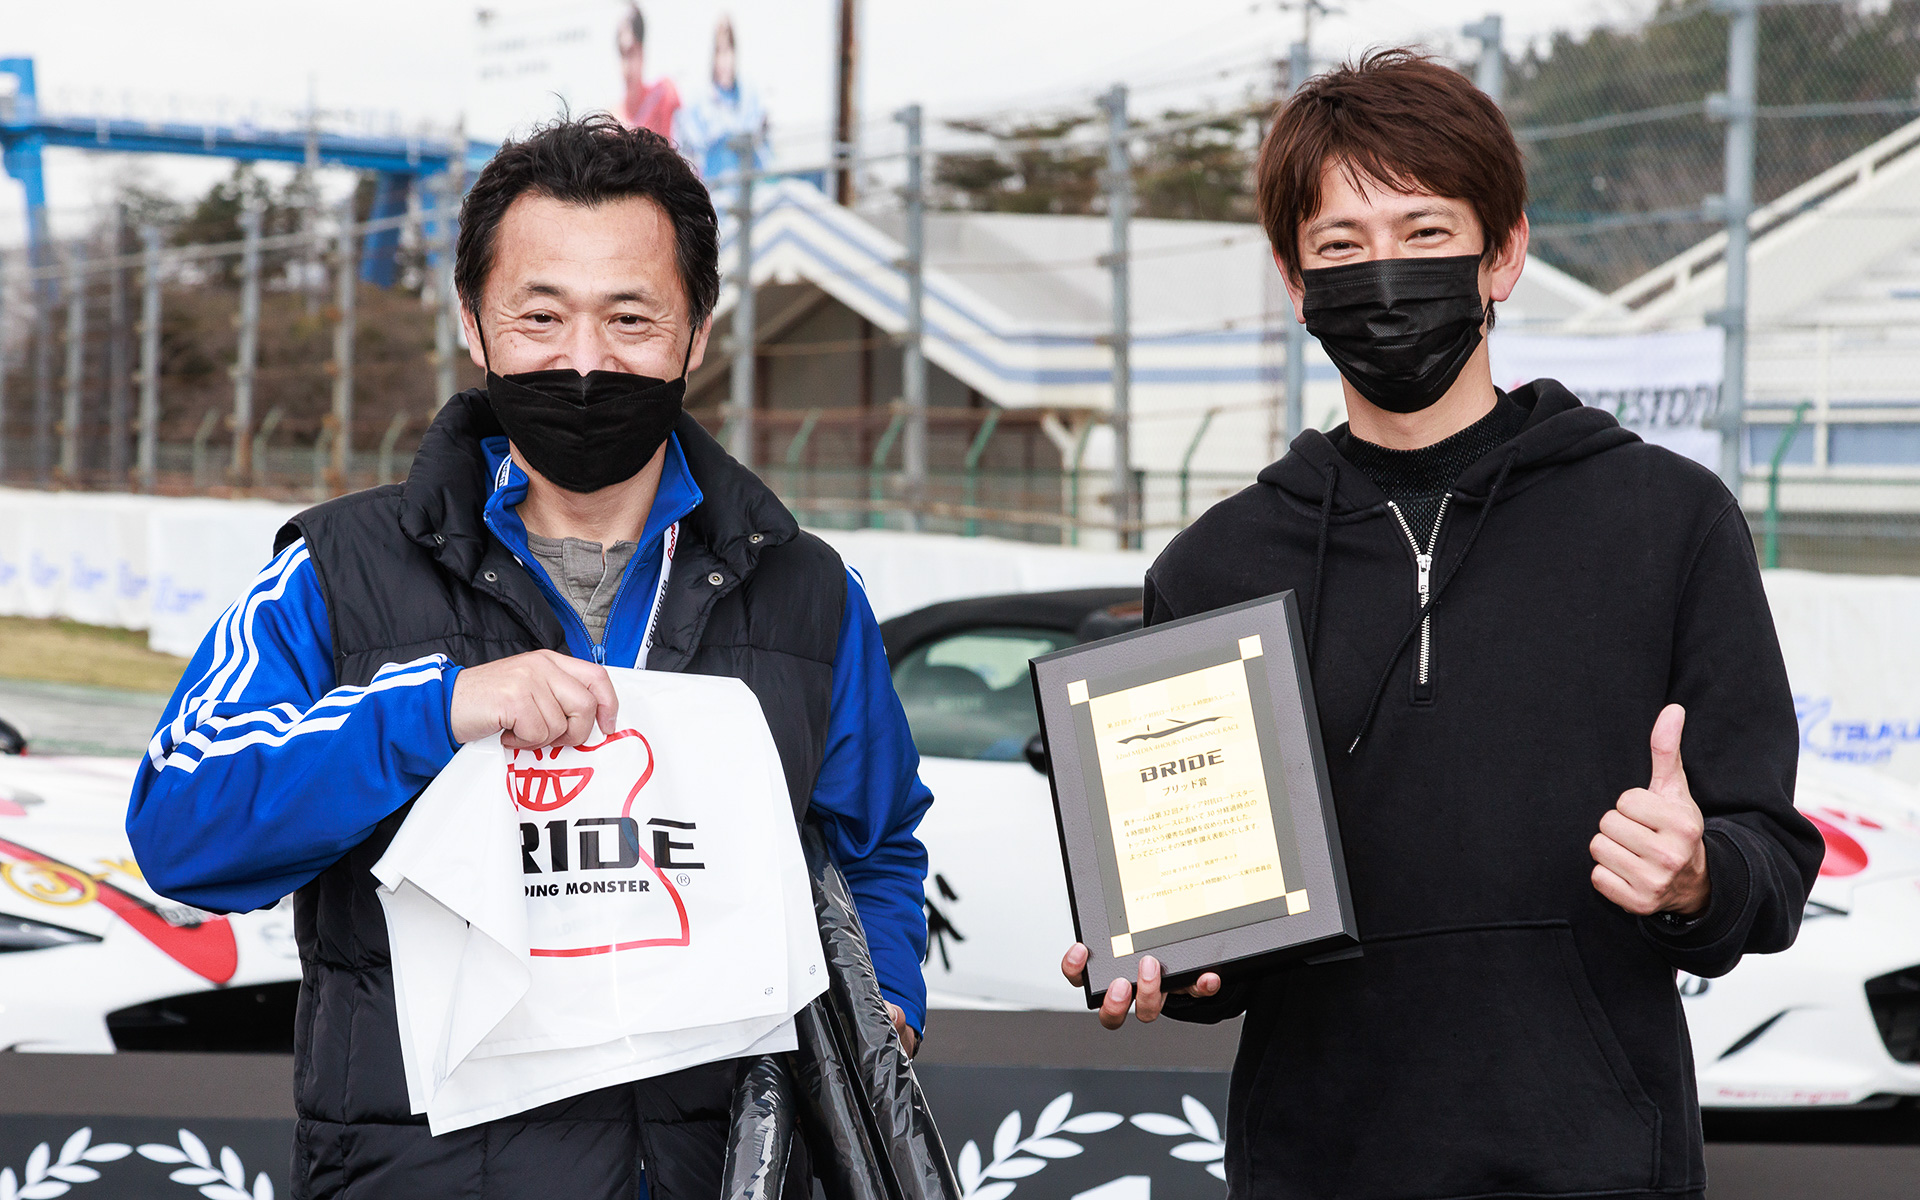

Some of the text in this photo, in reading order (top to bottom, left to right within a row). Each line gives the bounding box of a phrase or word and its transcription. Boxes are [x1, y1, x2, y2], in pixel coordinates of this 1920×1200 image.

[1130, 746, 1153, 756] MEDIA
[1153, 738, 1181, 750] 4HOURS
[1181, 728, 1221, 743] ENDURANCE
[1222, 724, 1239, 733] RACE
[1139, 748, 1224, 783] BRIDE
[1161, 776, 1208, 797] ブリッド賞
[525, 880, 650, 898] ING MONSTER
